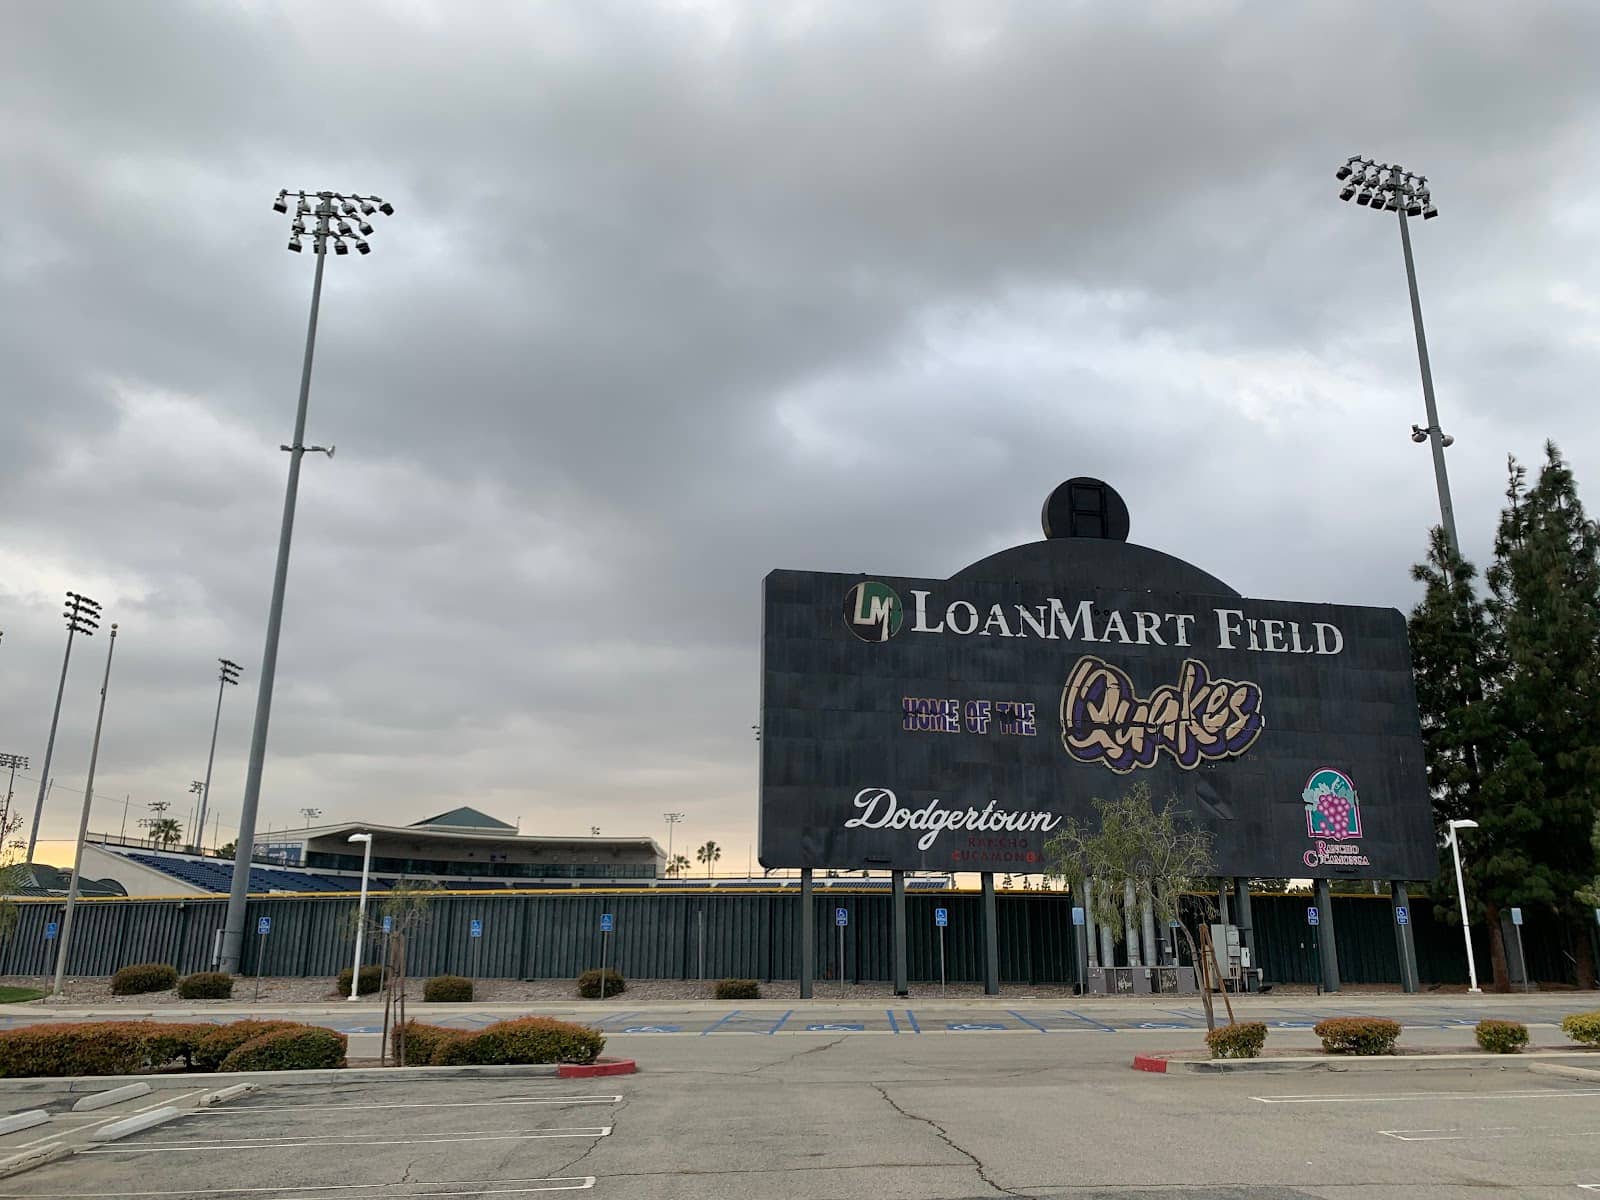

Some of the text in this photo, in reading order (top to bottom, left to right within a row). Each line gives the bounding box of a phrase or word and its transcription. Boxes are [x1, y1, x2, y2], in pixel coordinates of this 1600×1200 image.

[853, 581, 894, 642] LM
[1213, 608, 1344, 655] FIELD
[902, 697, 1037, 736] HOME OF THE
[1060, 655, 1265, 774] Quakes
[845, 787, 1063, 851] Dodgertown
